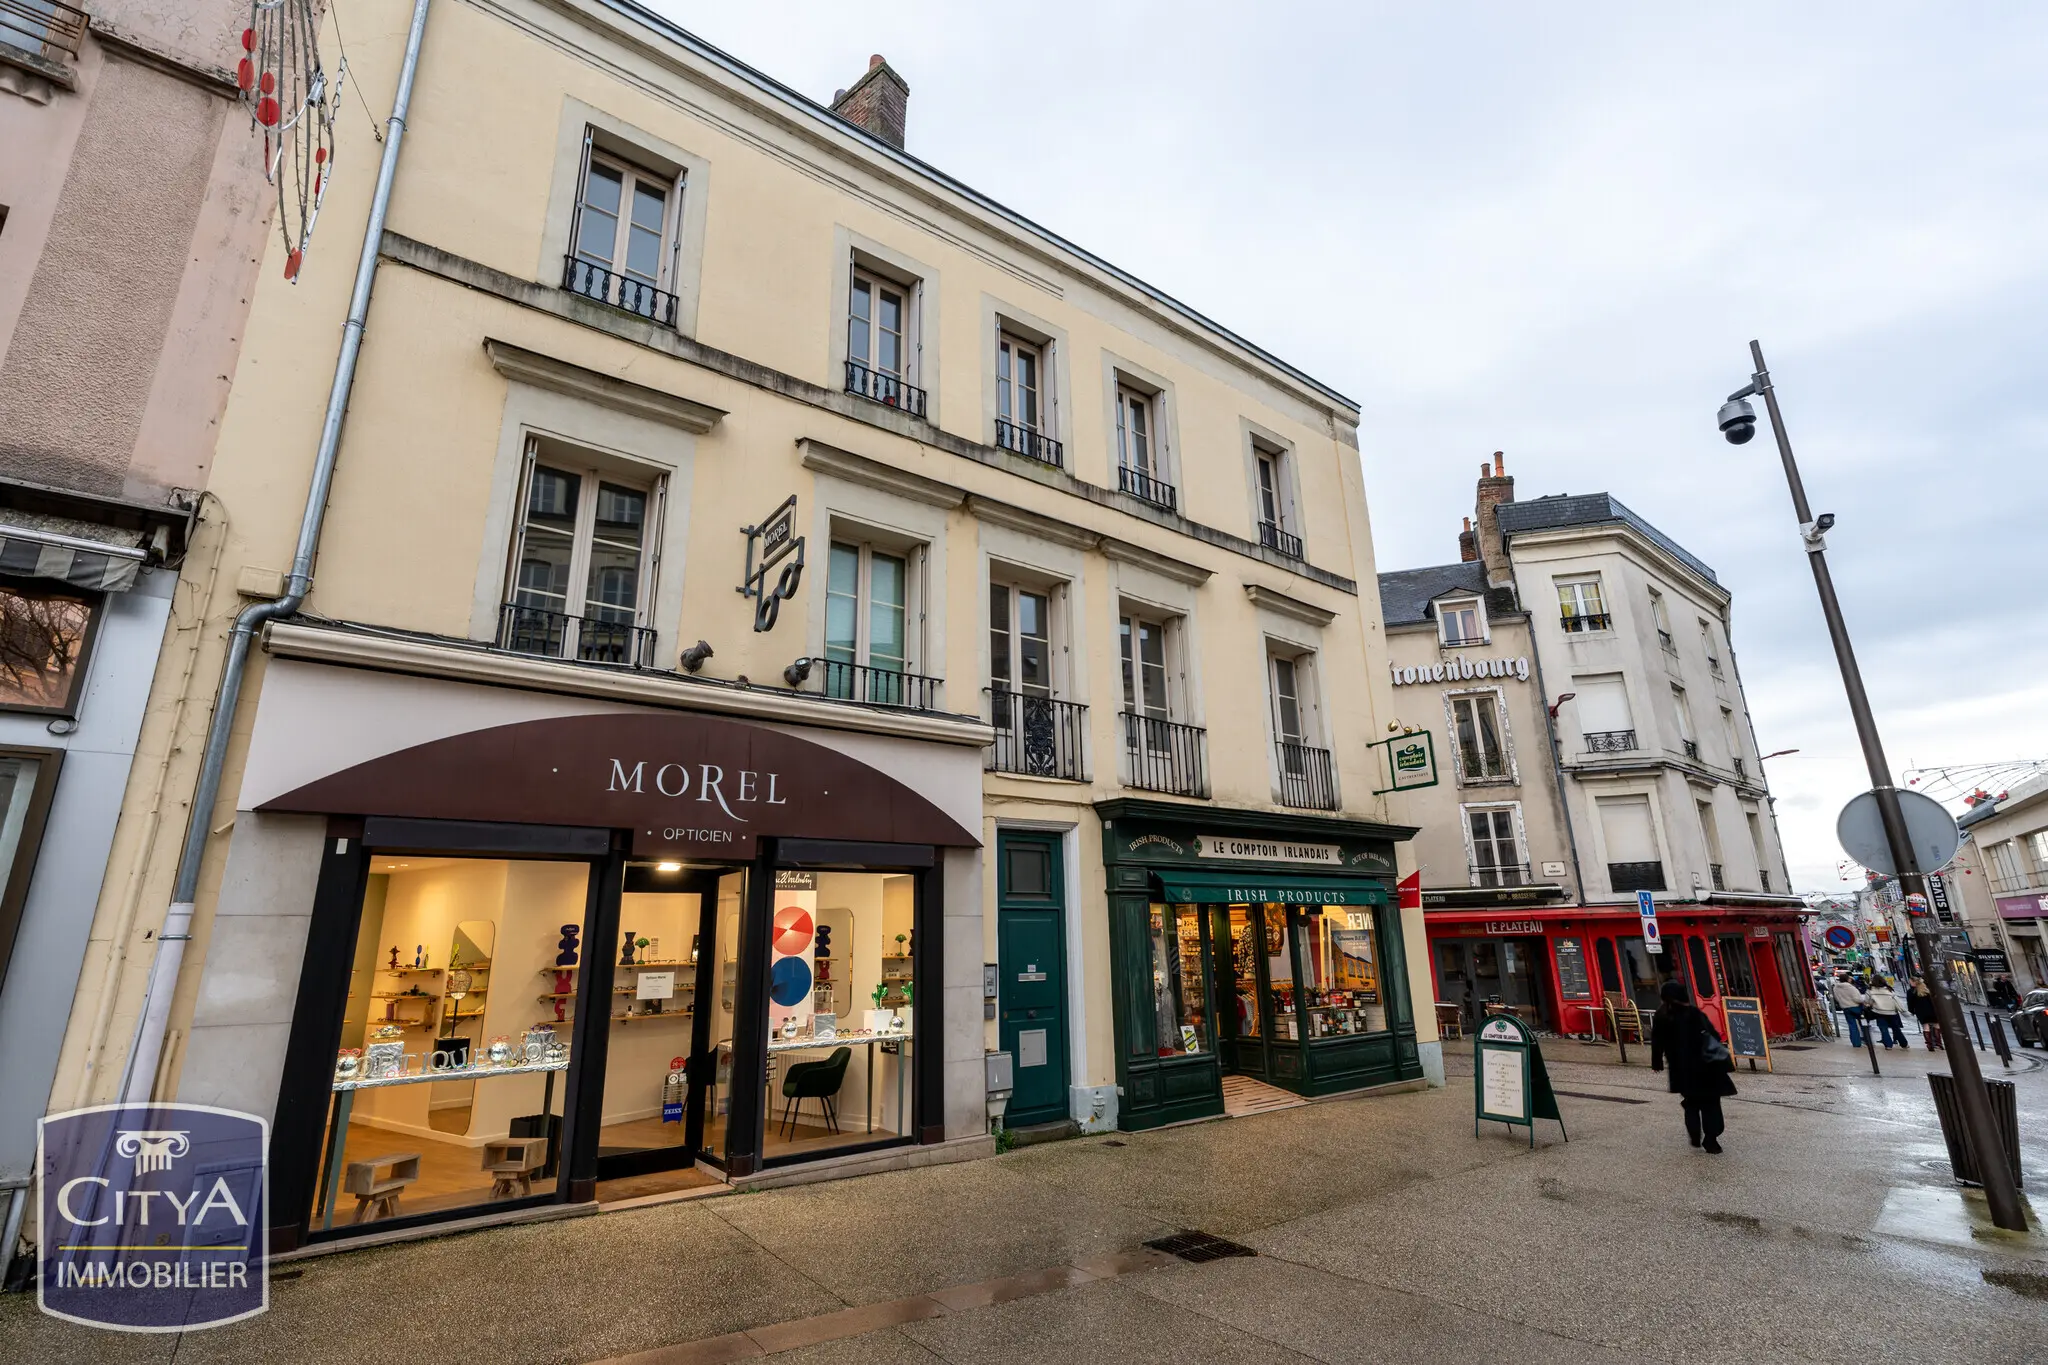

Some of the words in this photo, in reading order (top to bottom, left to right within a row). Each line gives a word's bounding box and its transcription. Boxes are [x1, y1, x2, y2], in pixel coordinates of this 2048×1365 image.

[1389, 653, 1529, 685] ronenbourg
[605, 758, 787, 822] MOREL
[663, 827, 733, 843] OPTICIEN
[1128, 835, 1148, 852] IRISH
[1149, 834, 1184, 856] PRODUCTS
[1213, 840, 1225, 855] LE
[1230, 842, 1279, 858] COMPTOIR
[1284, 845, 1330, 861] IRLANDAIS
[1351, 854, 1362, 865] OUT
[1361, 852, 1368, 860] OF
[1368, 852, 1390, 867] IRELAND
[1227, 889, 1268, 902] IRISH
[1278, 889, 1346, 903] PRODUCTS
[1485, 922, 1498, 934] LE
[1500, 920, 1544, 934] PLATEAU
